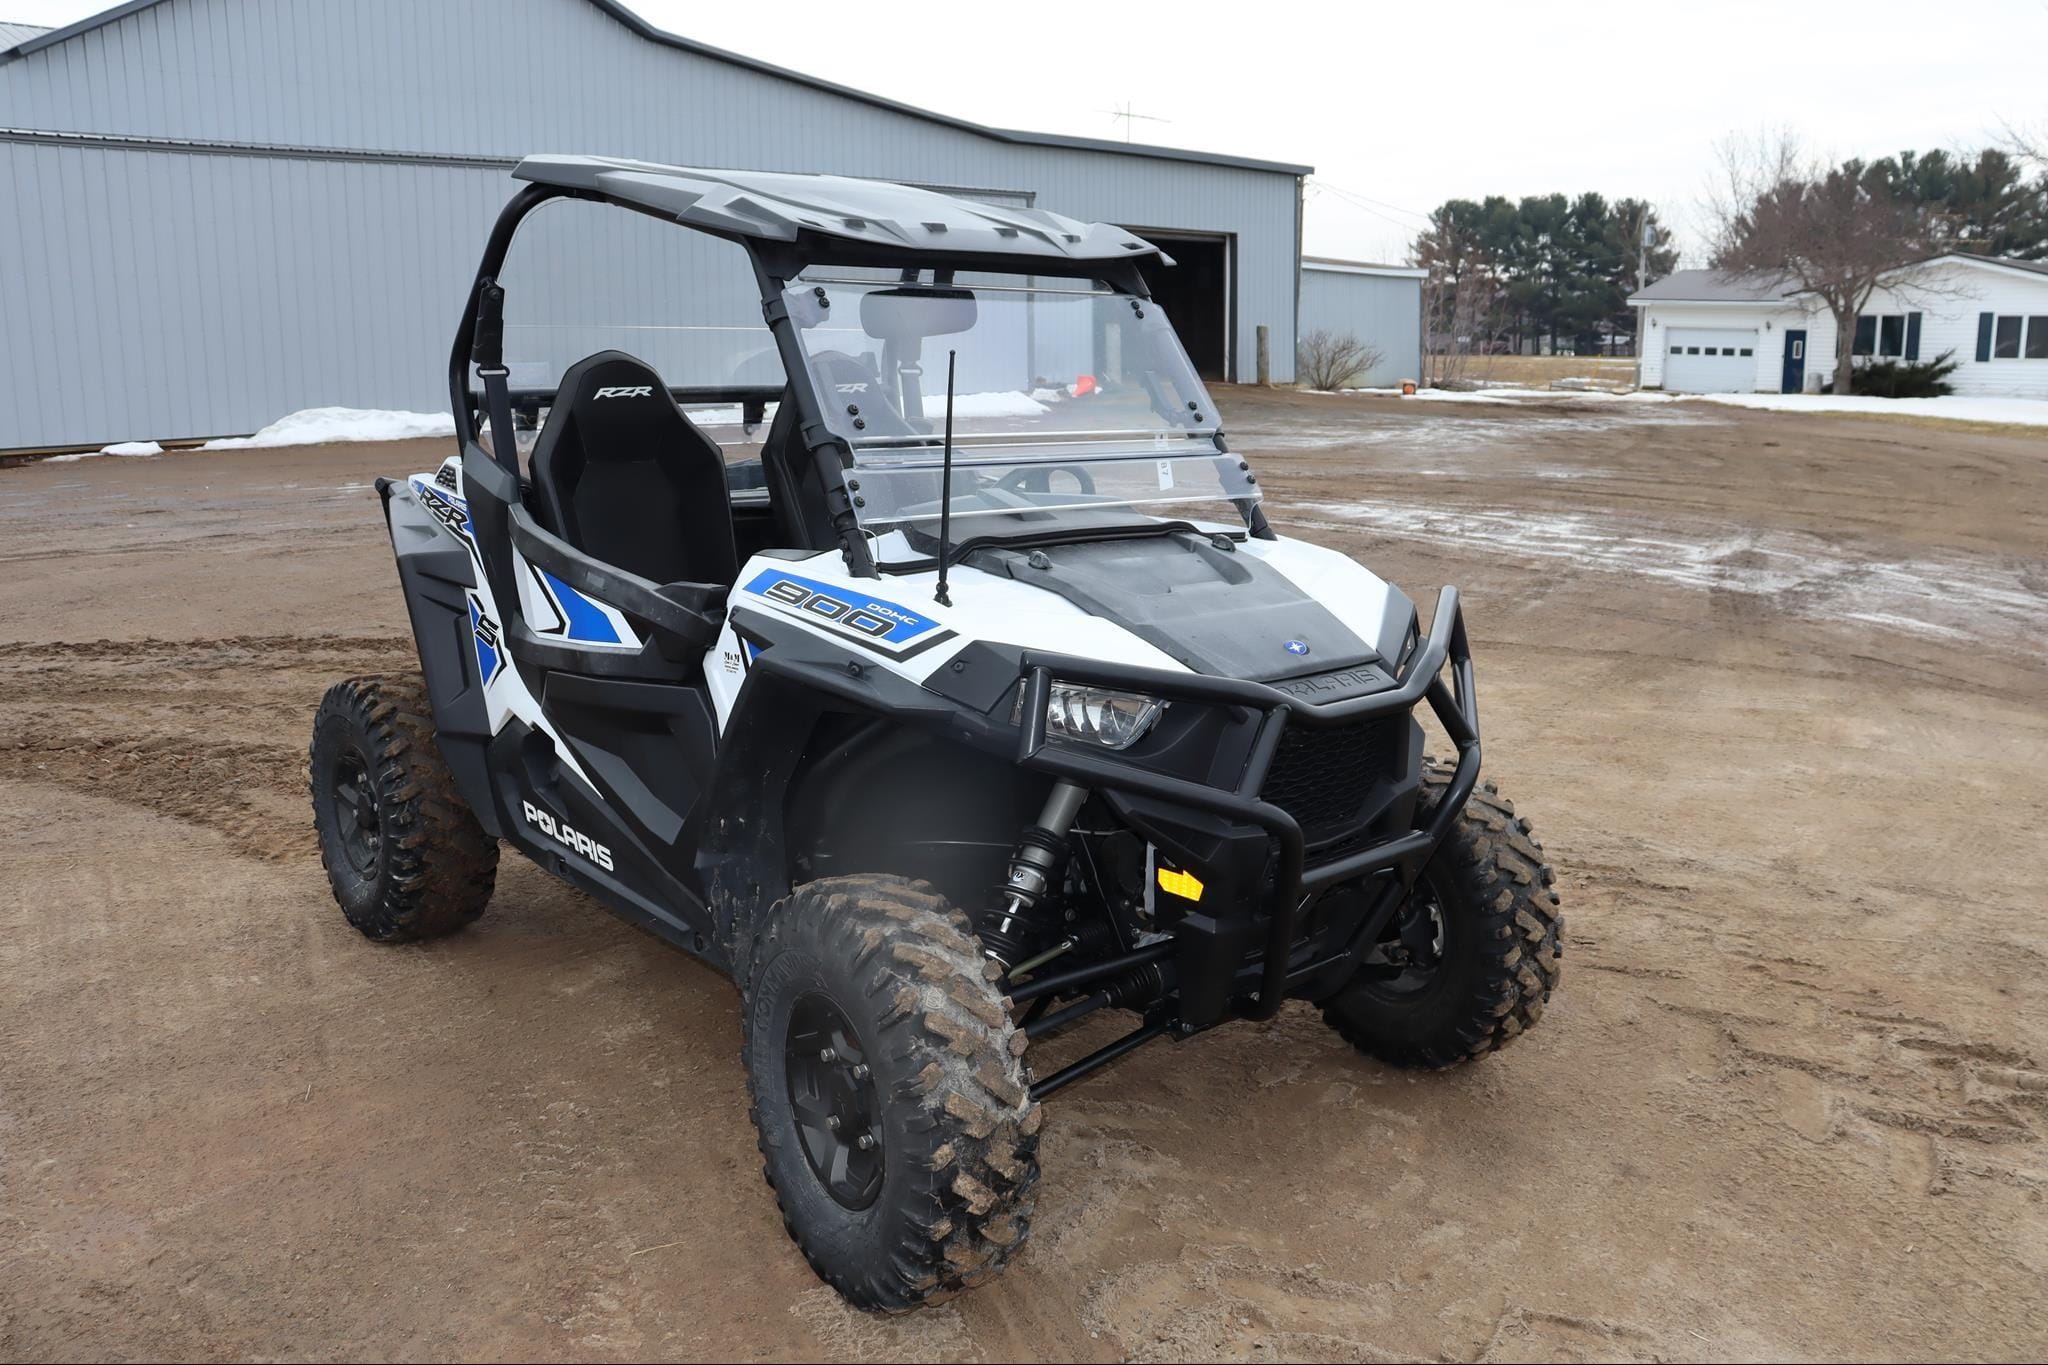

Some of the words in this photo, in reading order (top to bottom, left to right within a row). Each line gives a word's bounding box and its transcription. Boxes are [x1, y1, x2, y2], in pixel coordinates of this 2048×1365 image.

[593, 386, 653, 400] RZR
[835, 383, 868, 393] ZR
[420, 486, 470, 533] RZR
[764, 579, 897, 639] 900
[866, 602, 919, 626] DOHC
[522, 799, 614, 872] POLARIS
